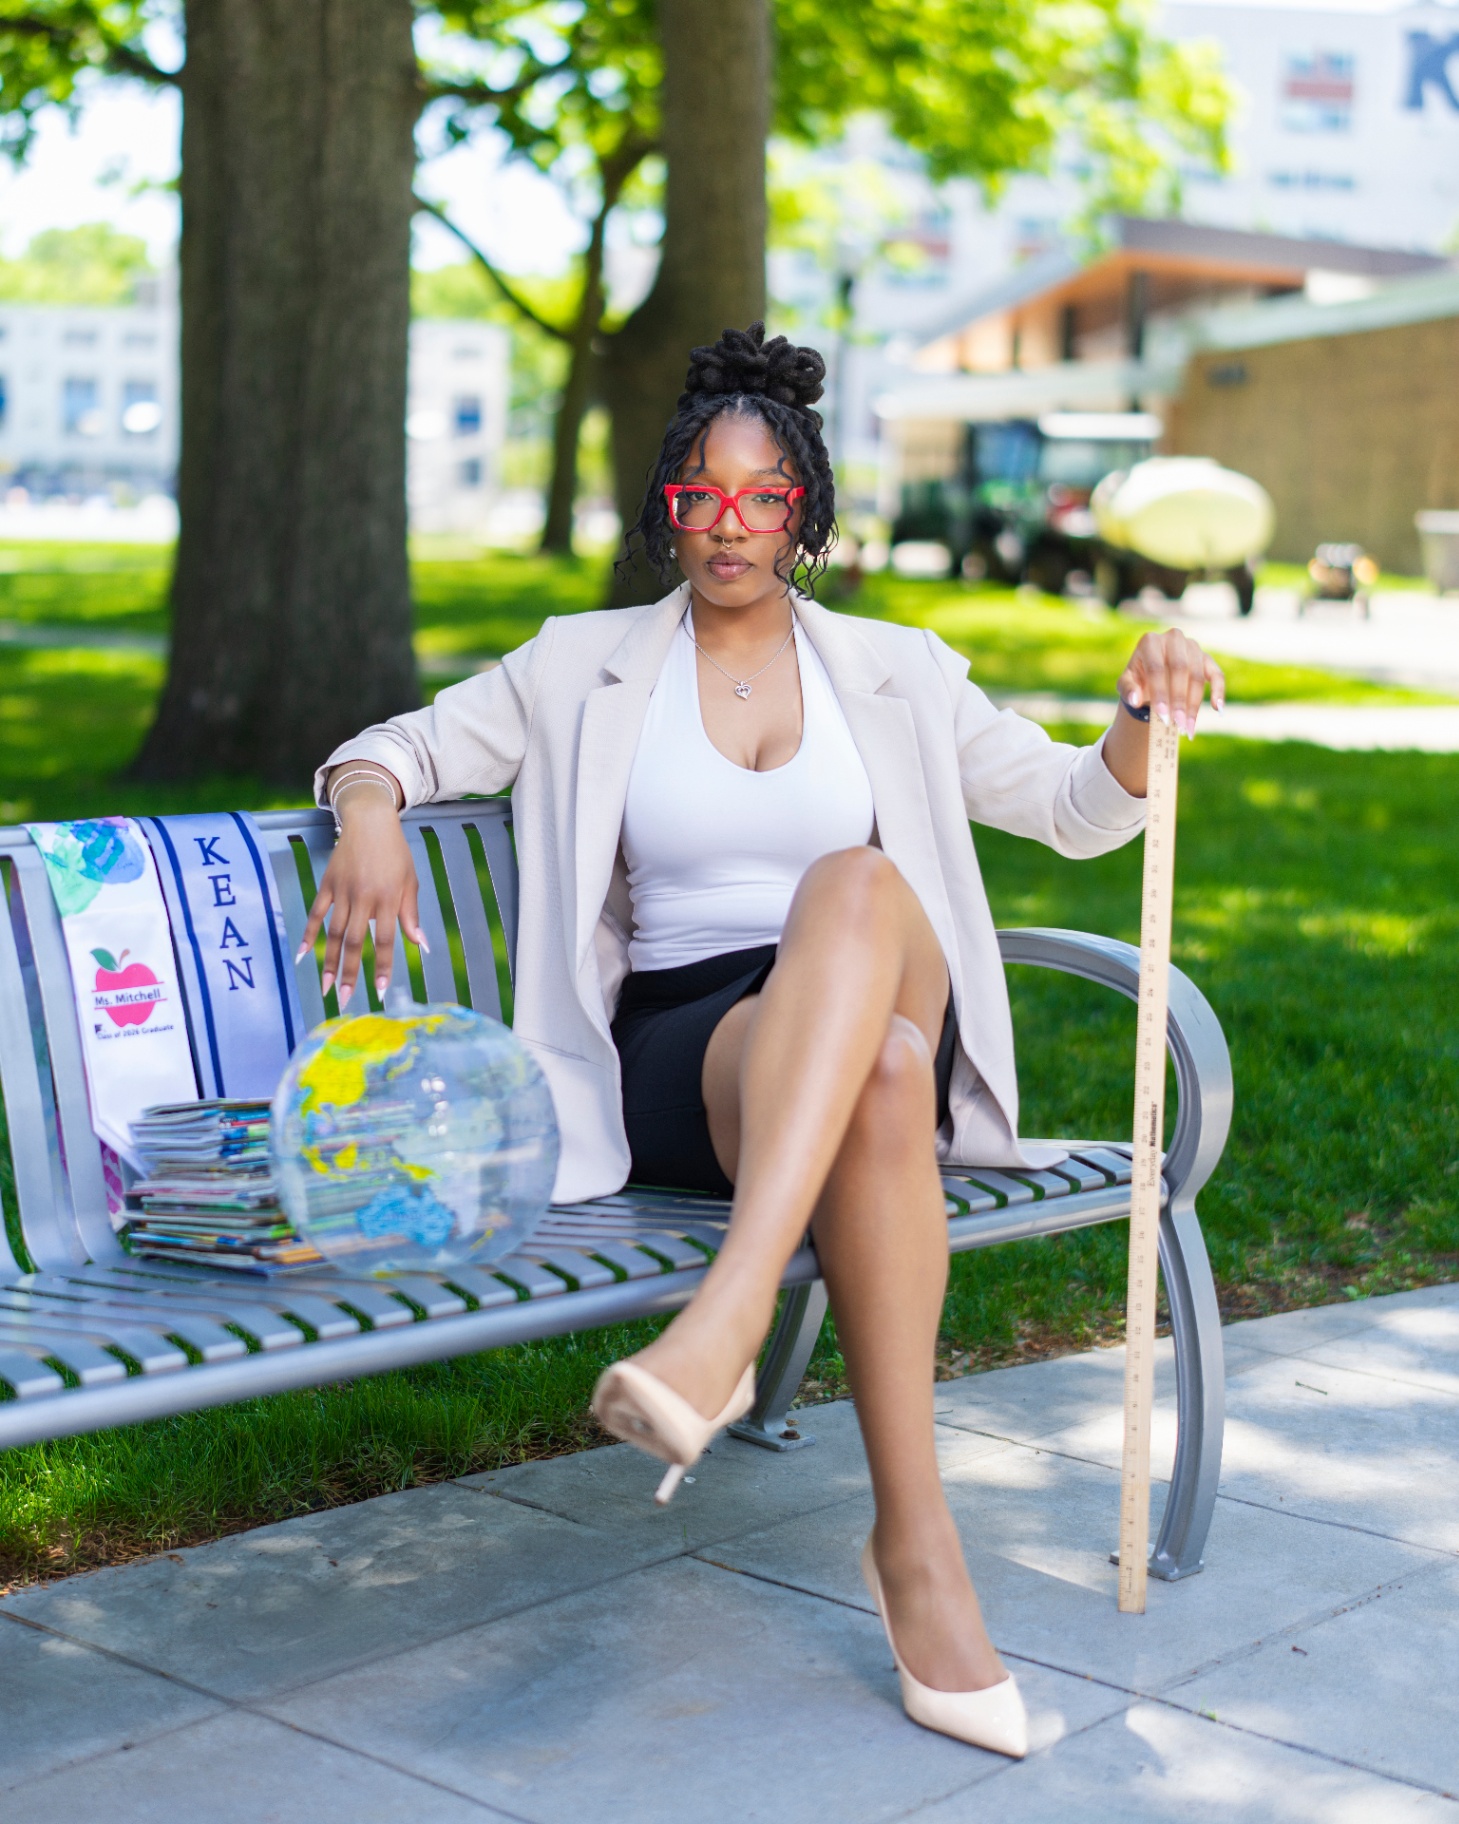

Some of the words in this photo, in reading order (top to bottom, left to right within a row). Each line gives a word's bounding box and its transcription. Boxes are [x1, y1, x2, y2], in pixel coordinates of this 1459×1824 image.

[193, 836, 256, 991] KEAN
[95, 996, 112, 1005] Ms.
[115, 988, 161, 1003] Mitchell
[141, 1024, 174, 1034] Graduate
[1149, 1102, 1157, 1147] Mathematics
[1147, 1150, 1157, 1186] Everyday
